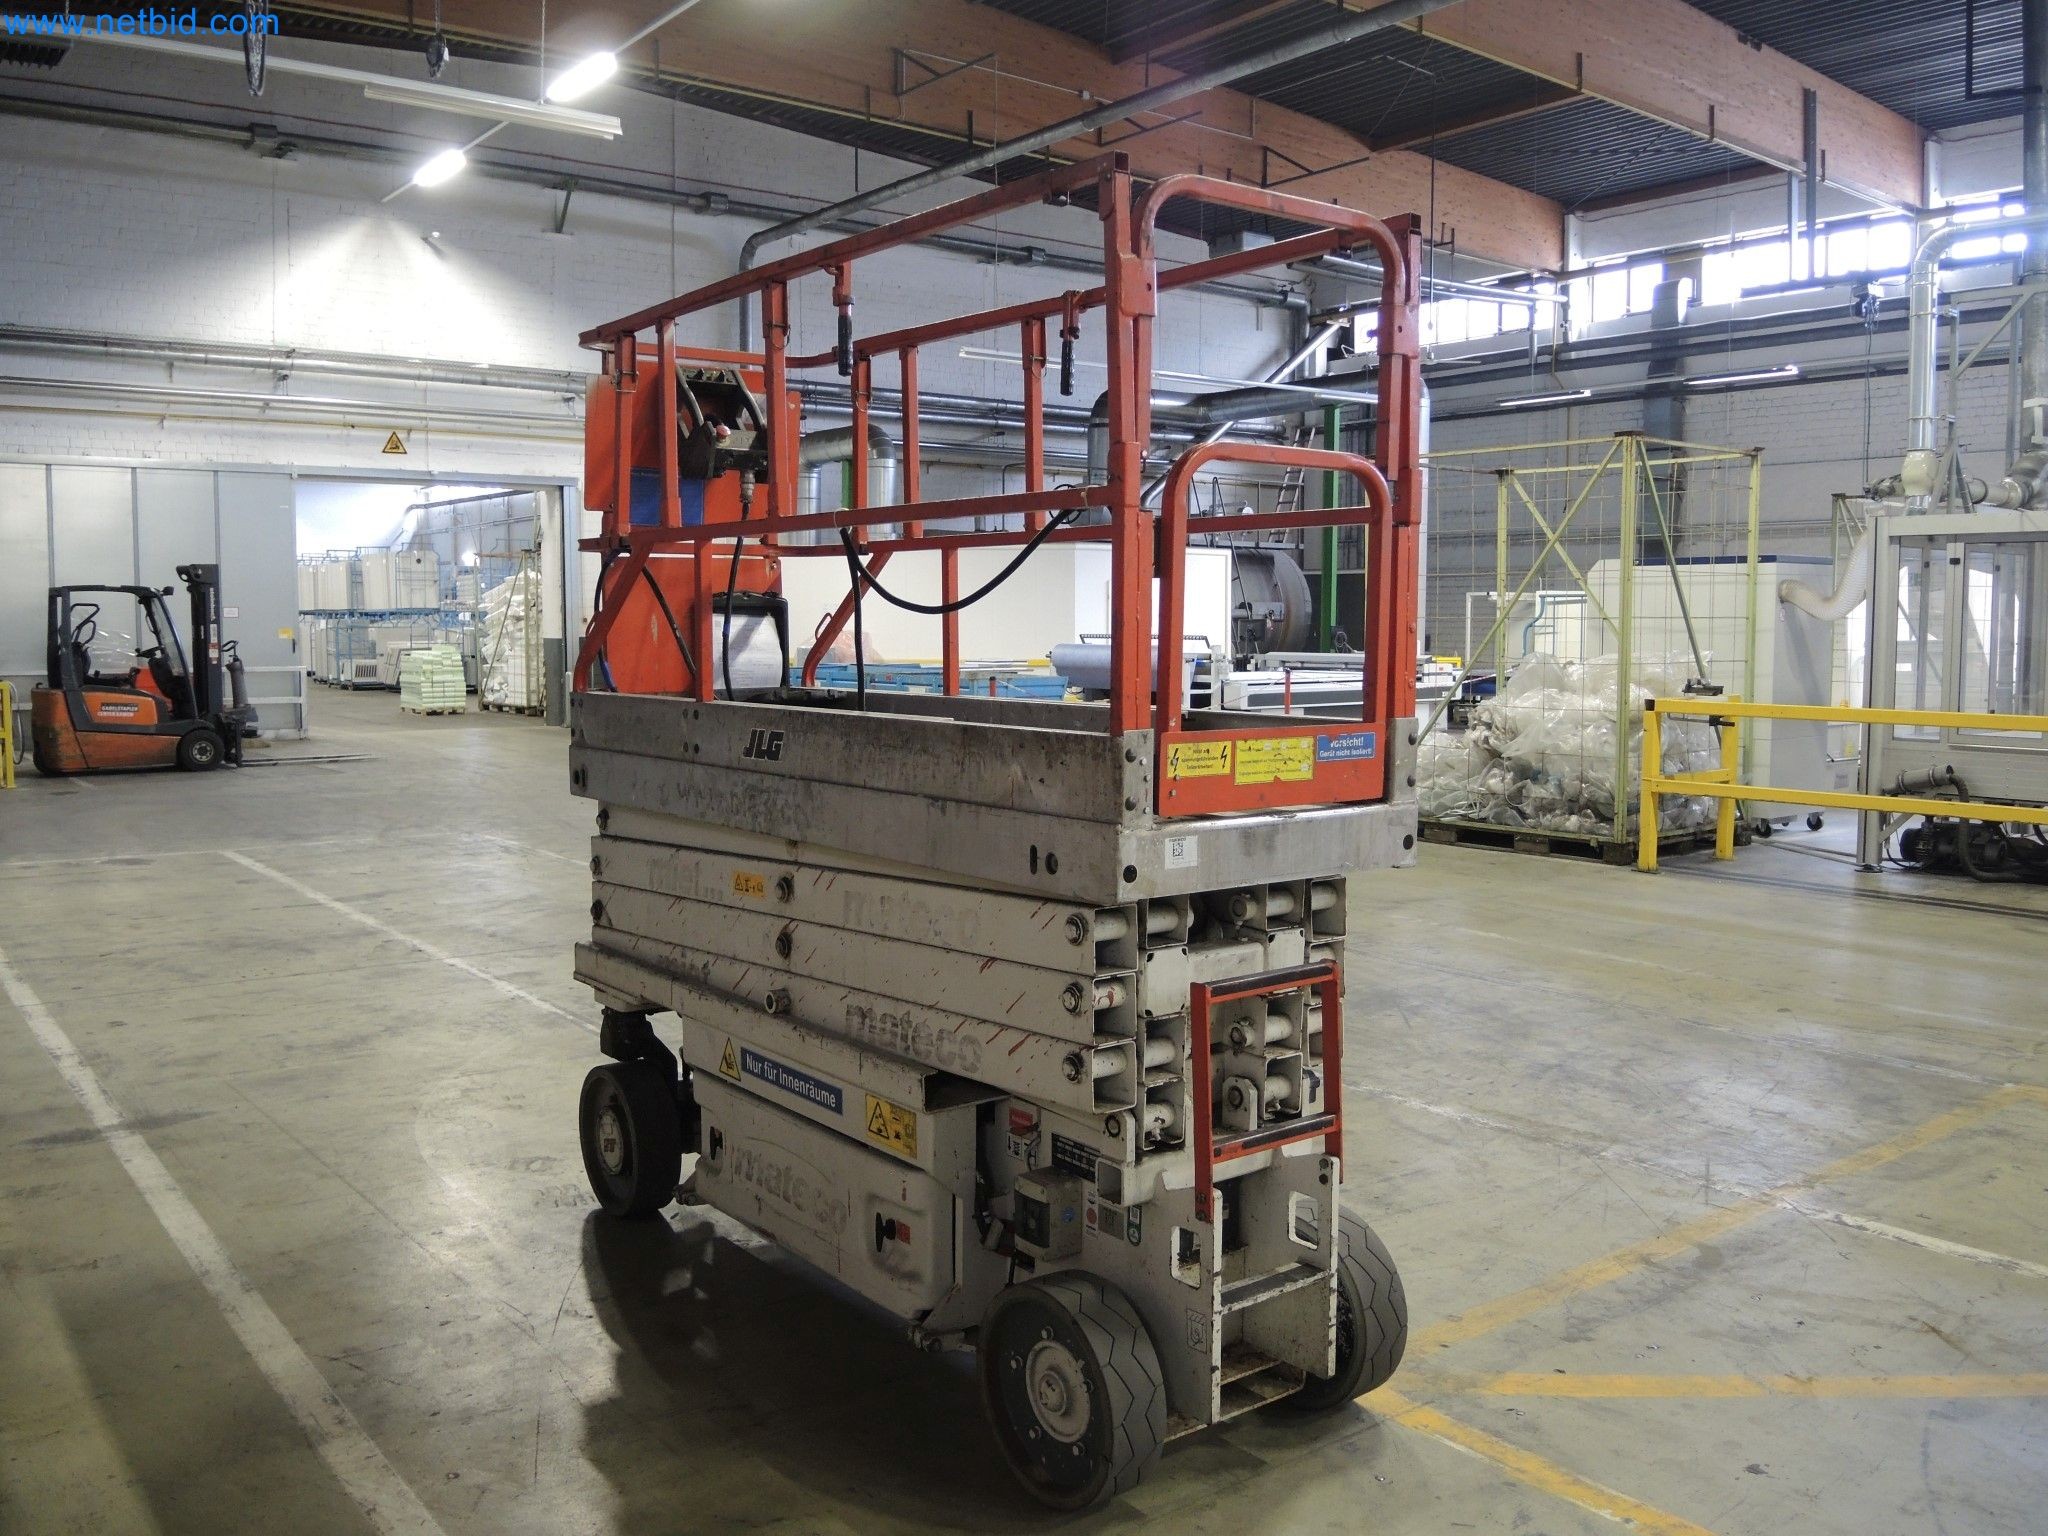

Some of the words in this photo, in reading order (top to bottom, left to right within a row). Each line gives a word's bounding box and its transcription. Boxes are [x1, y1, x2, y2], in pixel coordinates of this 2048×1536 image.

[743, 729, 784, 761] JLG
[746, 1053, 762, 1074] Nur
[764, 1061, 777, 1081] für
[779, 1067, 836, 1107] Innenräume
